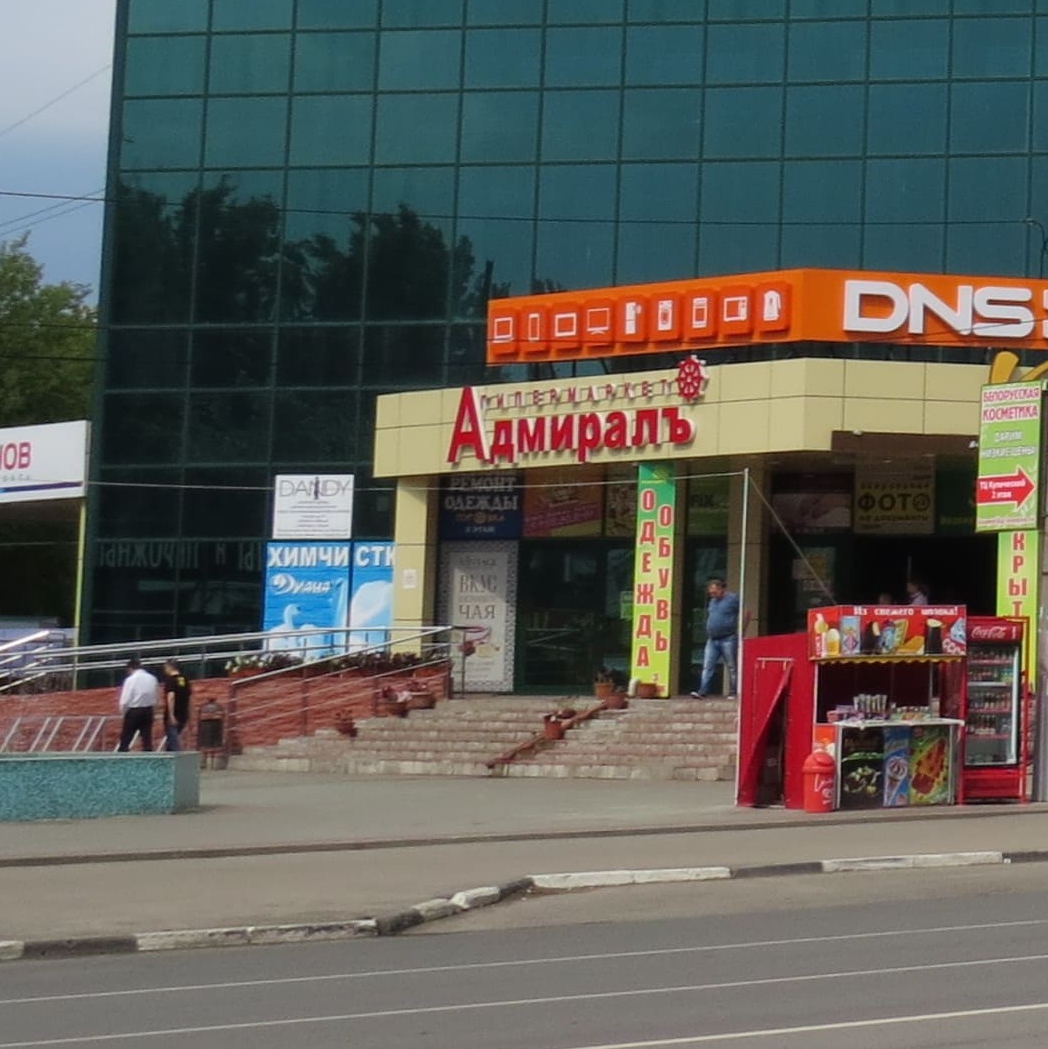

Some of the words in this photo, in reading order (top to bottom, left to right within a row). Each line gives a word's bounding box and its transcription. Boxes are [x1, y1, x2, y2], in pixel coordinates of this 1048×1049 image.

[843, 279, 1035, 338] DNS
[480, 379, 671, 409] ГИПЕРМАРКЕТ
[983, 386, 1040, 403] БЕЛОРУССКАЯ
[447, 386, 694, 464] Адмиралъ
[982, 403, 1039, 421] КОСМЕТИКА
[0, 442, 31, 471] ОВ
[449, 476, 517, 492] РЕМОНТ
[444, 495, 519, 511] ОДЕЖДЫ
[636, 489, 656, 667] ОДЕЖДА
[654, 505, 672, 652] ОБУВЬ
[458, 605, 496, 621] ЧАЯ
